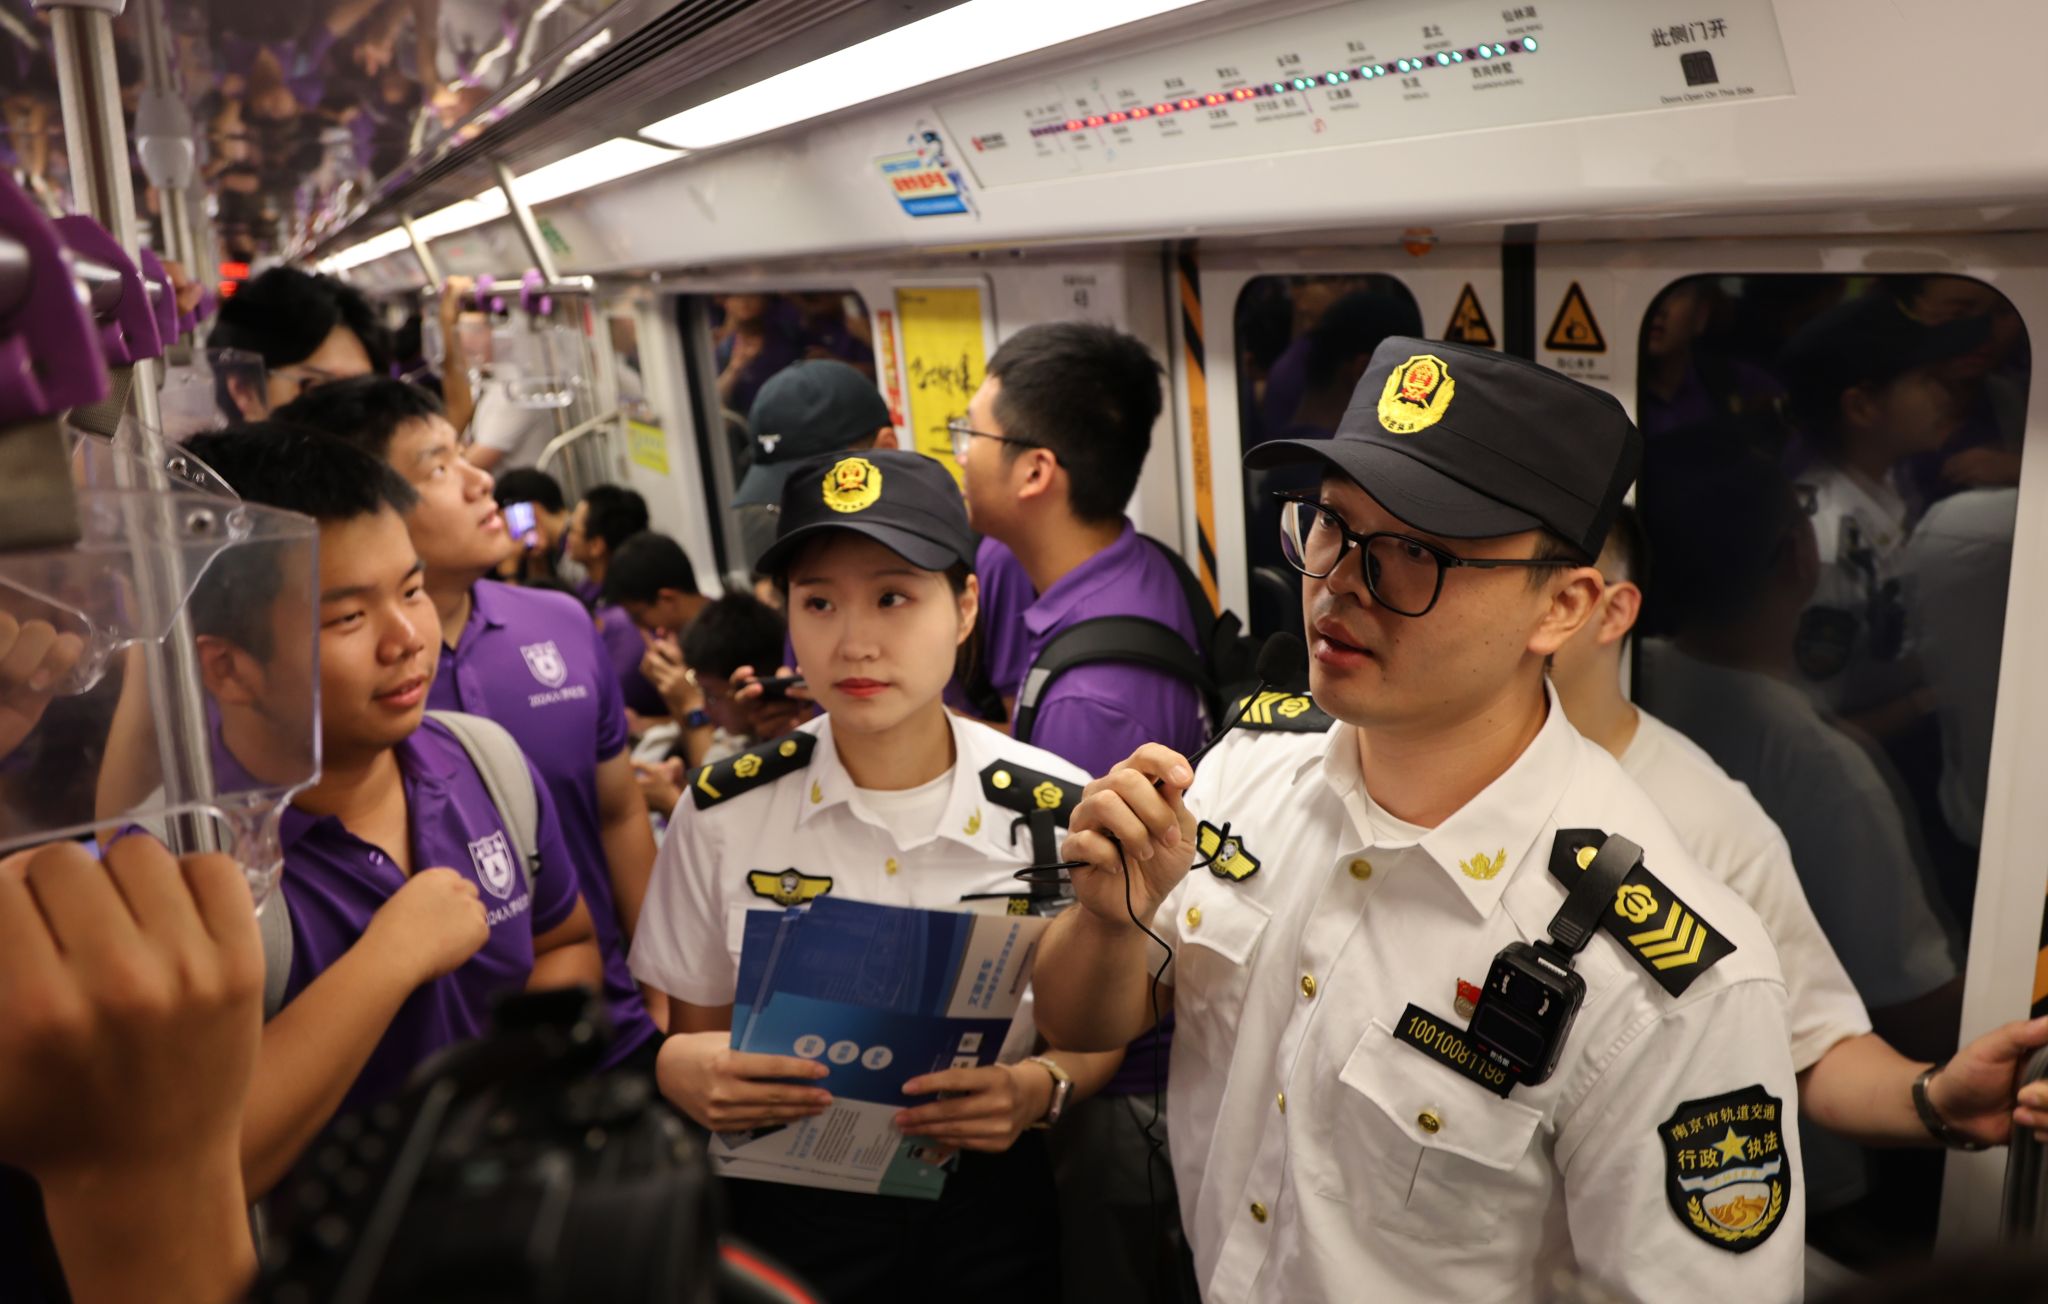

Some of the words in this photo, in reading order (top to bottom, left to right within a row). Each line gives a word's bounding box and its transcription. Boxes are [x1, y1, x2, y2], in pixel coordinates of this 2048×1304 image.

[1651, 17, 1727, 48] 此侧门开
[1671, 1103, 1776, 1142] 南京市轨道交通
[1677, 1148, 1720, 1170] 行政
[1747, 1130, 1779, 1160] 执法
